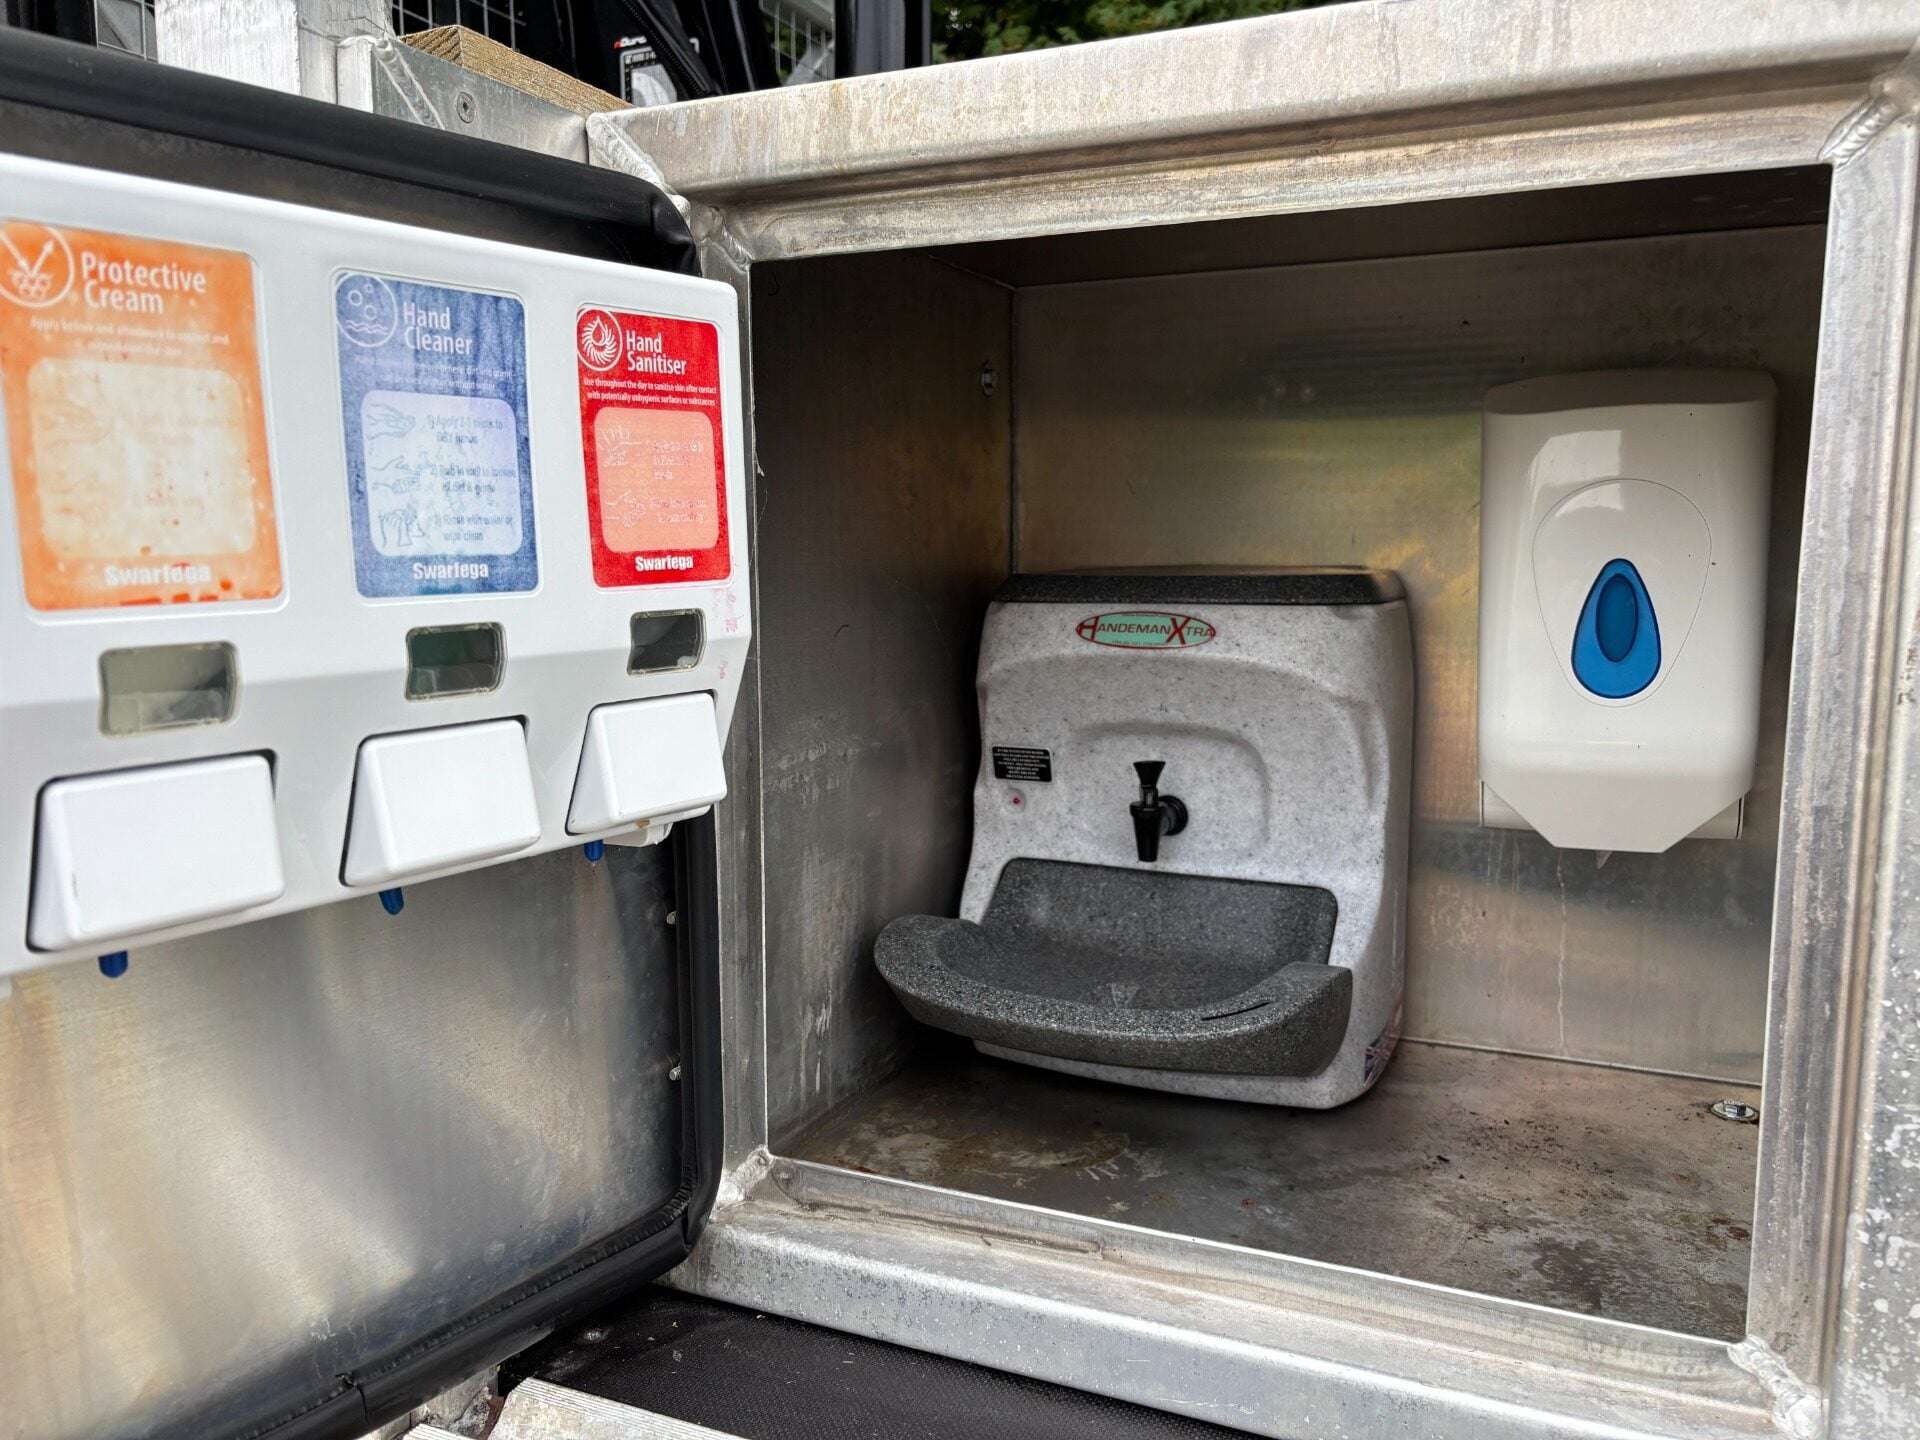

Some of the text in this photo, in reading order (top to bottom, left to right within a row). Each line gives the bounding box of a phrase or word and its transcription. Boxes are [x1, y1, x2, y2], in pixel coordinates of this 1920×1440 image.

[81, 251, 206, 293] Protective
[84, 280, 163, 314] Cream
[403, 301, 450, 330] Hand
[404, 326, 473, 354] Cleaner
[626, 330, 662, 353] Hand
[628, 351, 687, 374] Sanitiser
[584, 377, 594, 386] Use
[595, 378, 626, 389] throughout
[627, 380, 636, 389] the
[637, 381, 647, 391] day
[686, 384, 698, 393] after
[699, 385, 717, 394] contact
[587, 391, 601, 400] with
[601, 392, 631, 403] potentially
[104, 563, 211, 587] Swarfega
[413, 562, 489, 580] Swarfega
[635, 555, 693, 572] Swarfega
